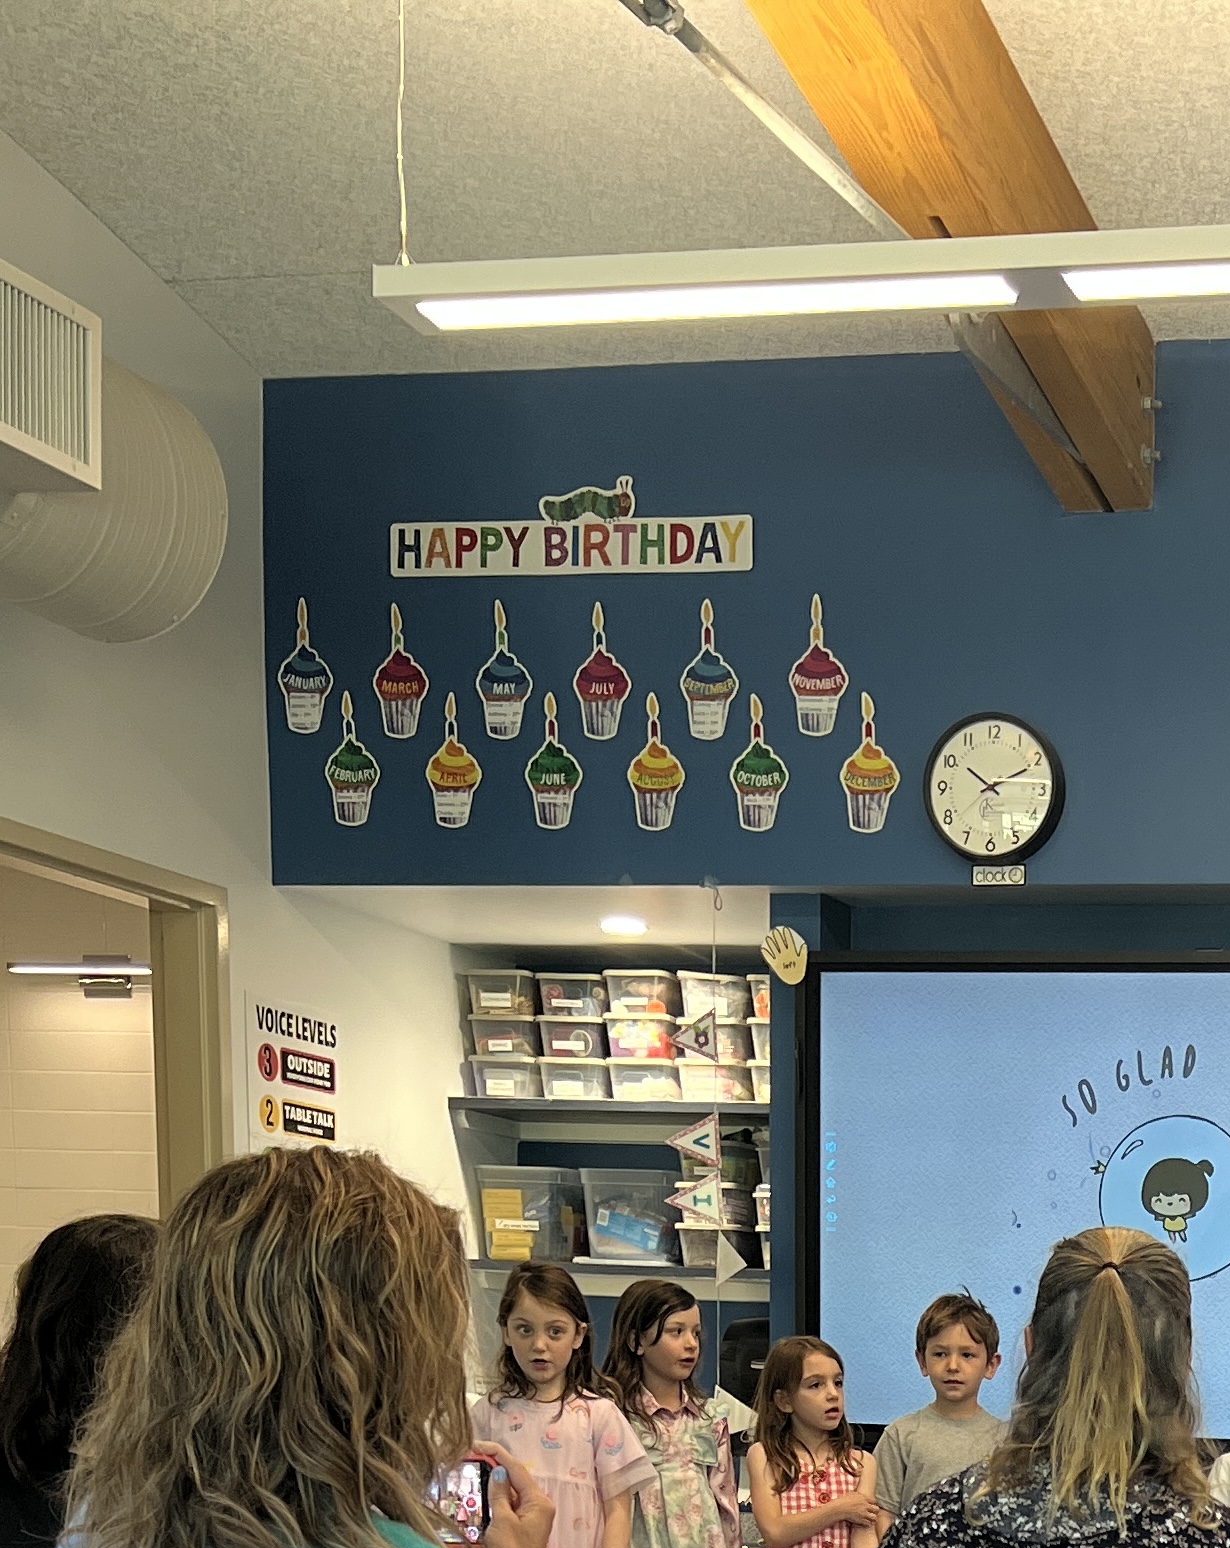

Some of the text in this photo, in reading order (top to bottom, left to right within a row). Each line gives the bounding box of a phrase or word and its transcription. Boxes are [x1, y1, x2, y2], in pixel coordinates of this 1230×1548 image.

[397, 520, 745, 569] HAPPY BIRTHDAY
[283, 673, 326, 690] JANUARY
[381, 680, 419, 693] MARCH
[492, 682, 516, 695] MAY
[589, 681, 615, 694] JULY
[684, 677, 735, 695] SEPTEMBER
[792, 673, 844, 690] NOVEMBER
[963, 732, 973, 747] 11
[987, 724, 1001, 740] 12
[943, 754, 957, 769] 10
[1034, 752, 1042, 766] 2
[328, 765, 375, 783] FEBRUARY
[439, 772, 468, 784] APRIL
[539, 773, 566, 785] JUNE
[736, 770, 780, 787] OCTOBER
[844, 771, 896, 788] DECEMBER
[937, 780, 948, 796] 9
[1038, 782, 1047, 797] 3
[943, 809, 953, 826] 8
[962, 831, 971, 846] 7
[985, 837, 996, 853] 6
[1011, 831, 1020, 845] 5
[974, 867, 1007, 883] clock
[256, 1004, 337, 1049] VOICE LEVELS
[263, 1046, 272, 1077] 3
[286, 1054, 331, 1079] OUTSIDE
[1062, 1044, 1196, 1128] SO GLAD
[265, 1098, 275, 1127] 2
[284, 1105, 334, 1128] TABLE TALK
